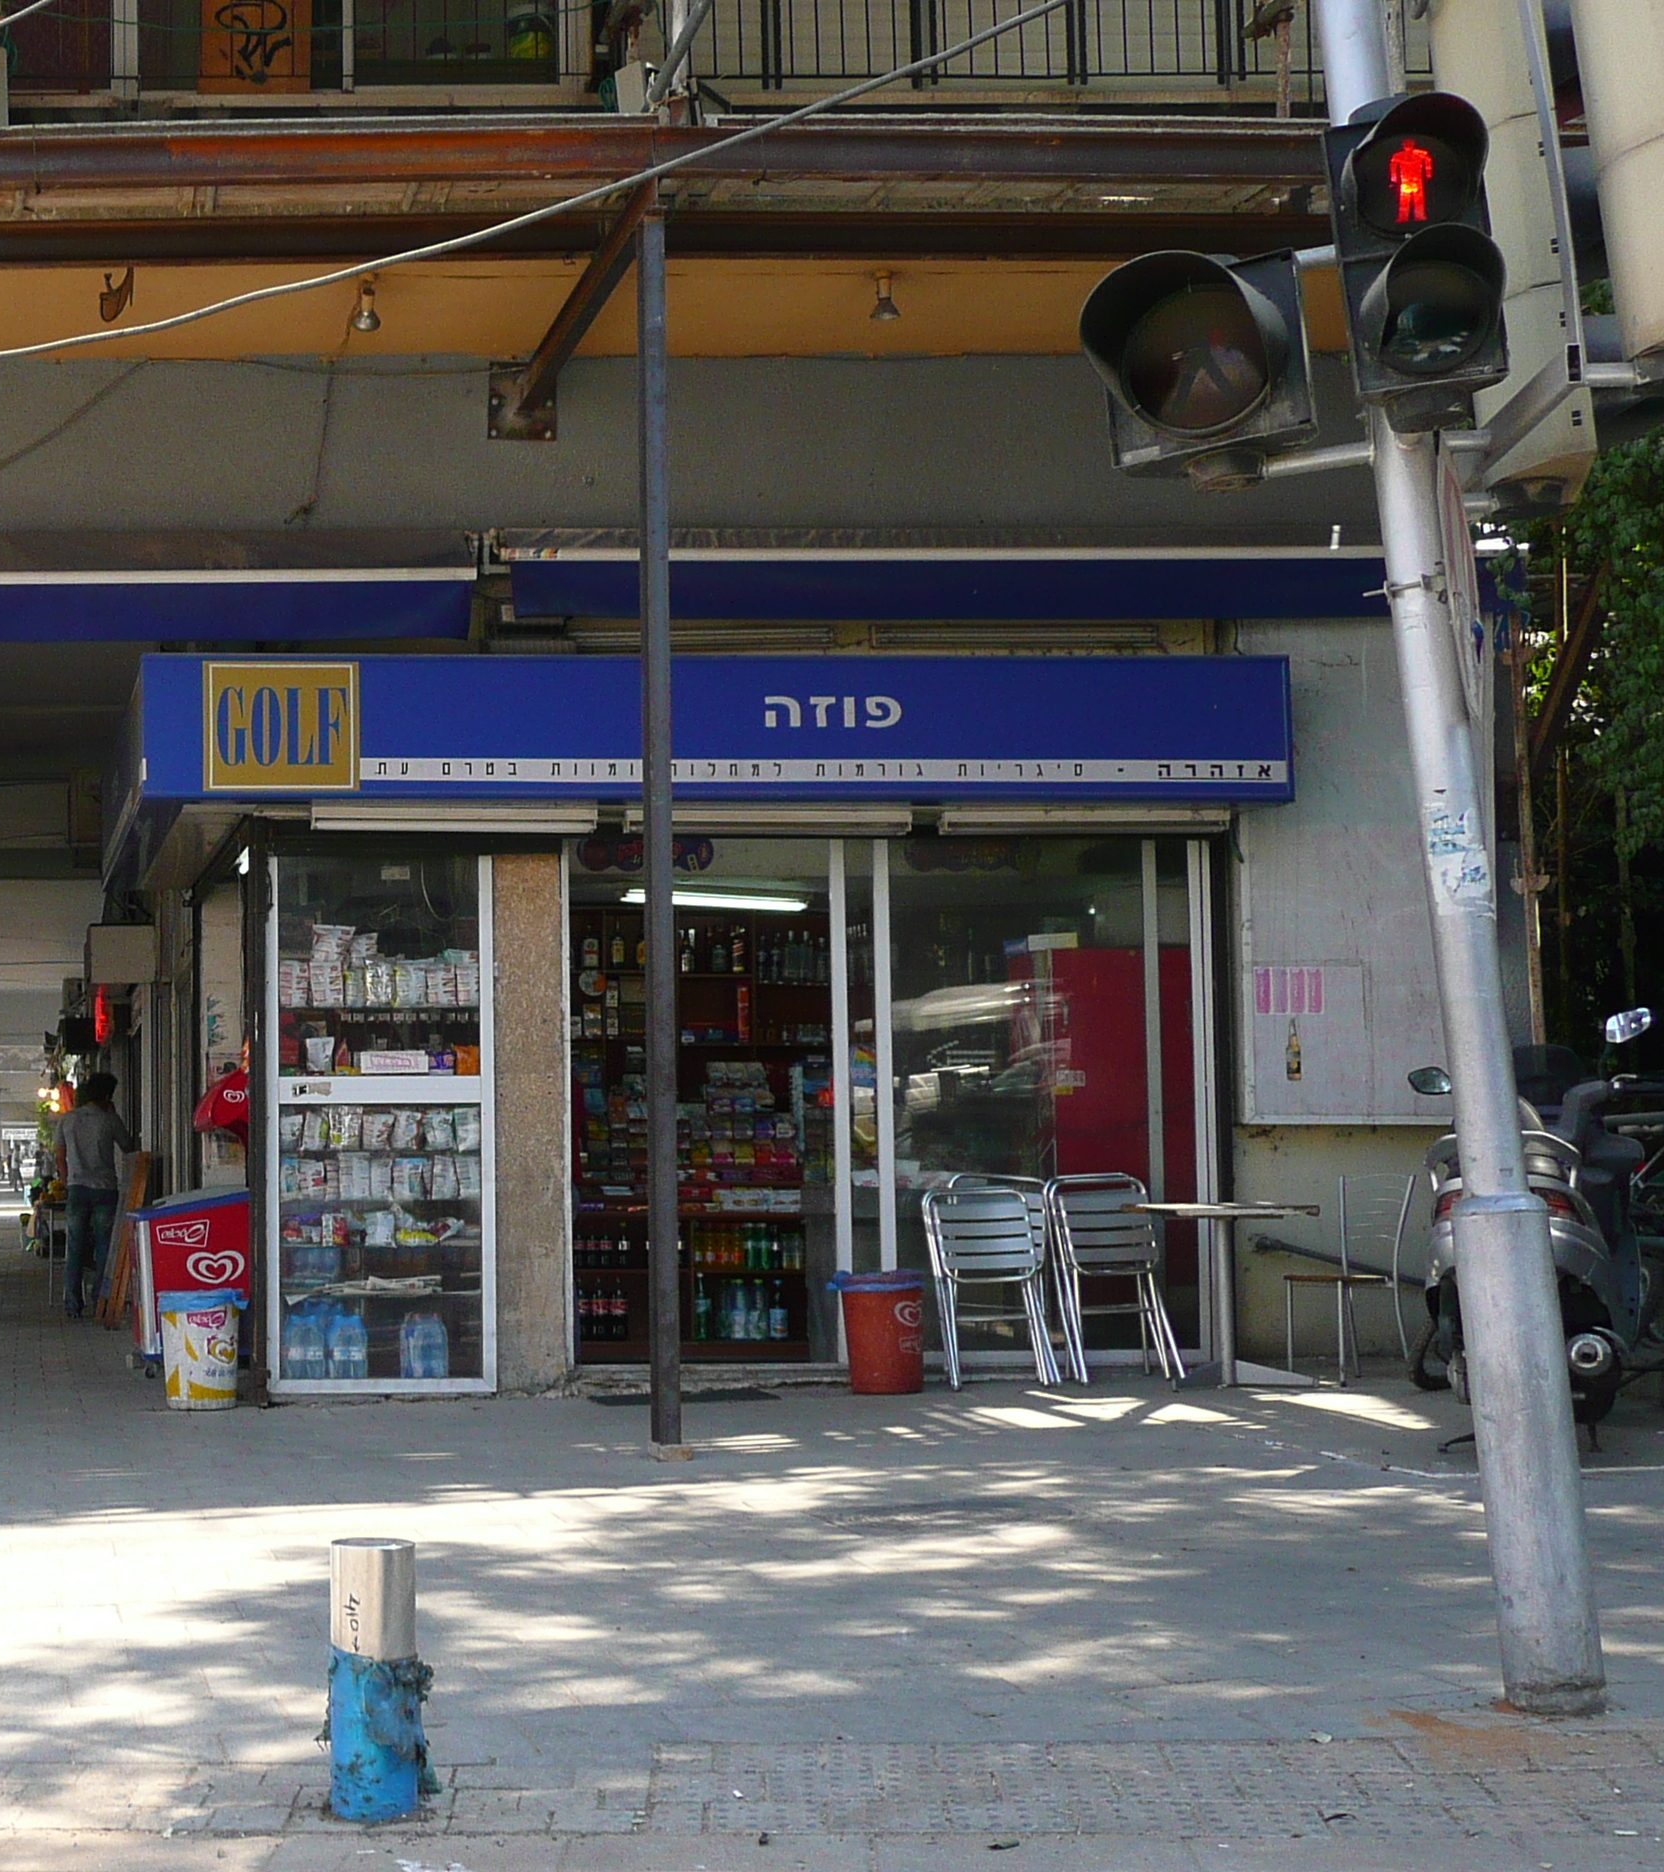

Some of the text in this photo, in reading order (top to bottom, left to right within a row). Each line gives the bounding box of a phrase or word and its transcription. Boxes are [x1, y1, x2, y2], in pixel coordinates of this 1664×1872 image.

[764, 696, 902, 728] פוזה
[216, 686, 347, 767] GOLF
[374, 761, 410, 776] עת
[441, 761, 518, 776] בטרם
[550, 762, 634, 777] ומוות
[815, 763, 924, 777] גורמות
[957, 763, 1084, 777] סיגריות
[1158, 764, 1272, 778] אזהרה
